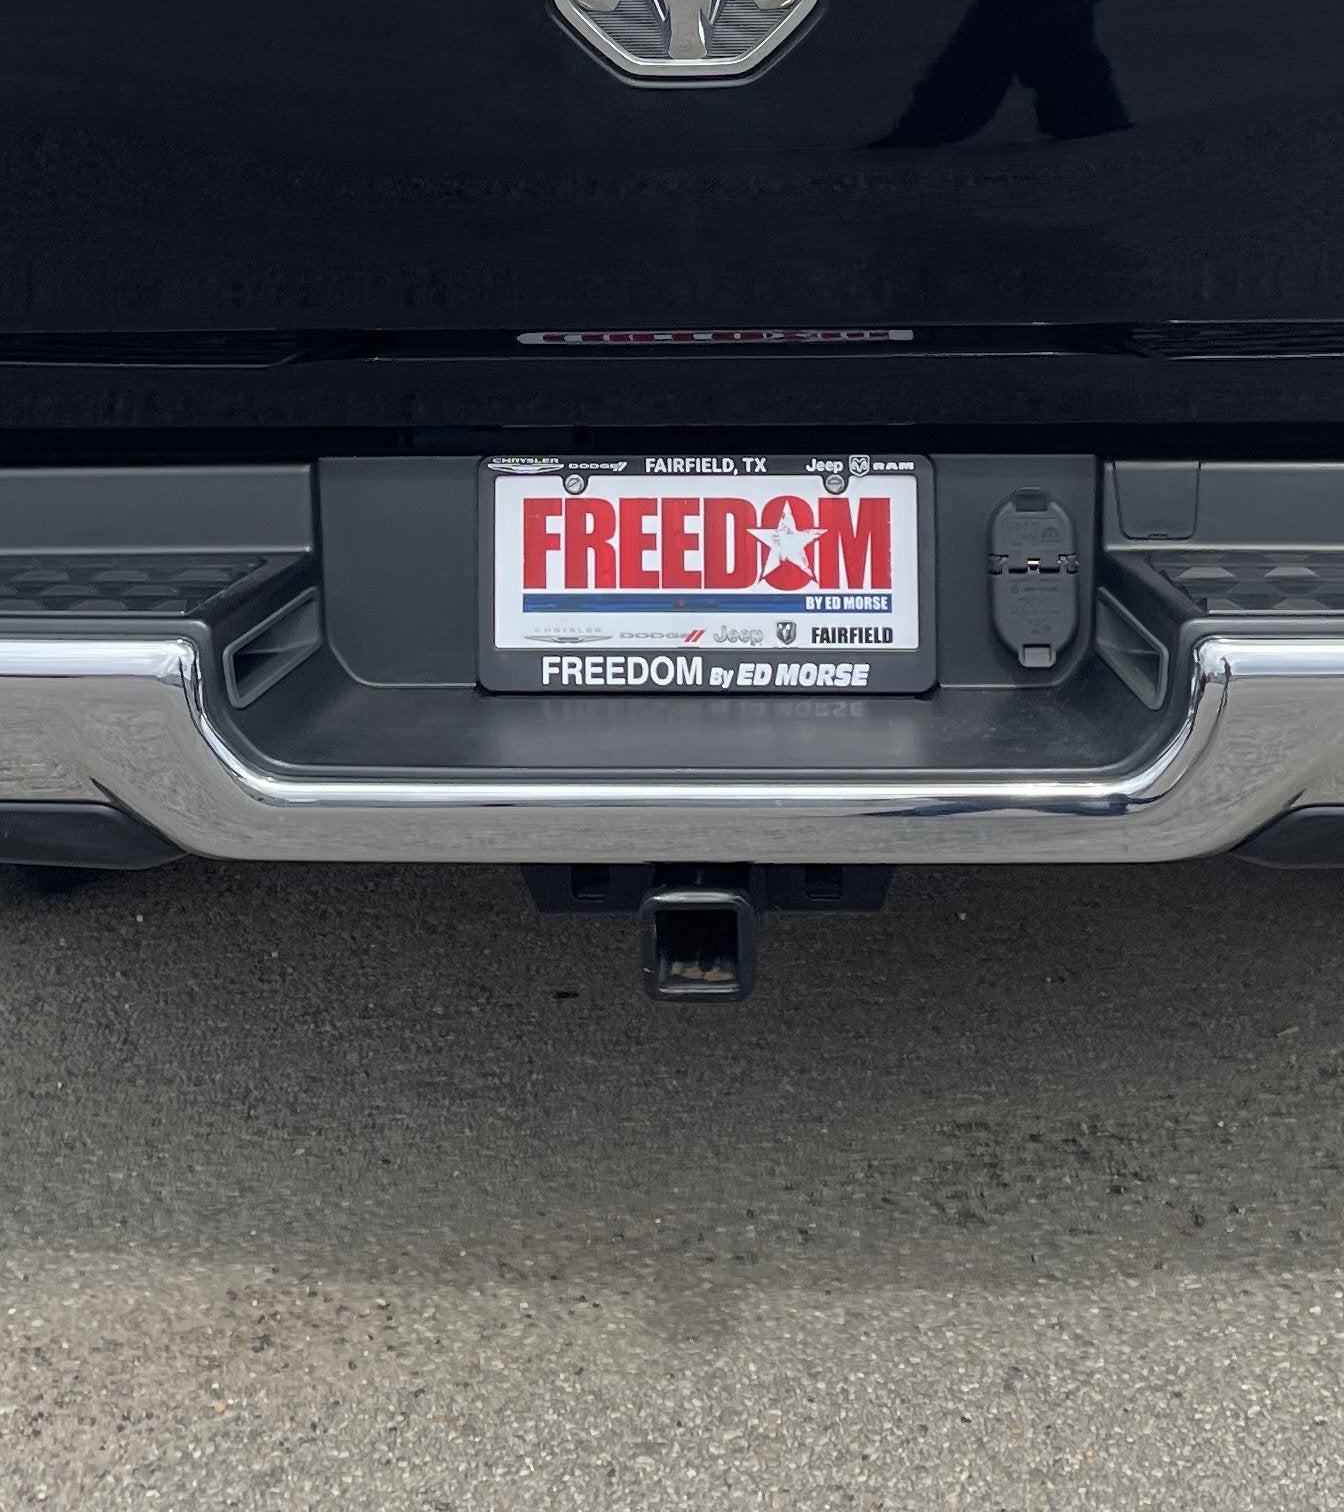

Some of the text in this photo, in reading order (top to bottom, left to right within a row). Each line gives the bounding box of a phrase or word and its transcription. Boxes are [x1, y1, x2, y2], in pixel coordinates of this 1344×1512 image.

[645, 457, 739, 476] FAIRFIELD,
[742, 457, 767, 473] TX
[805, 458, 844, 474] Jeep
[872, 461, 915, 471] RAM
[522, 495, 893, 592] FREEDOM
[805, 596, 888, 611] BY ED MORSE
[713, 624, 764, 646] Jeep
[811, 626, 894, 644] FAIRFIELD
[542, 656, 871, 689] FREEDOM By ED MORSE
